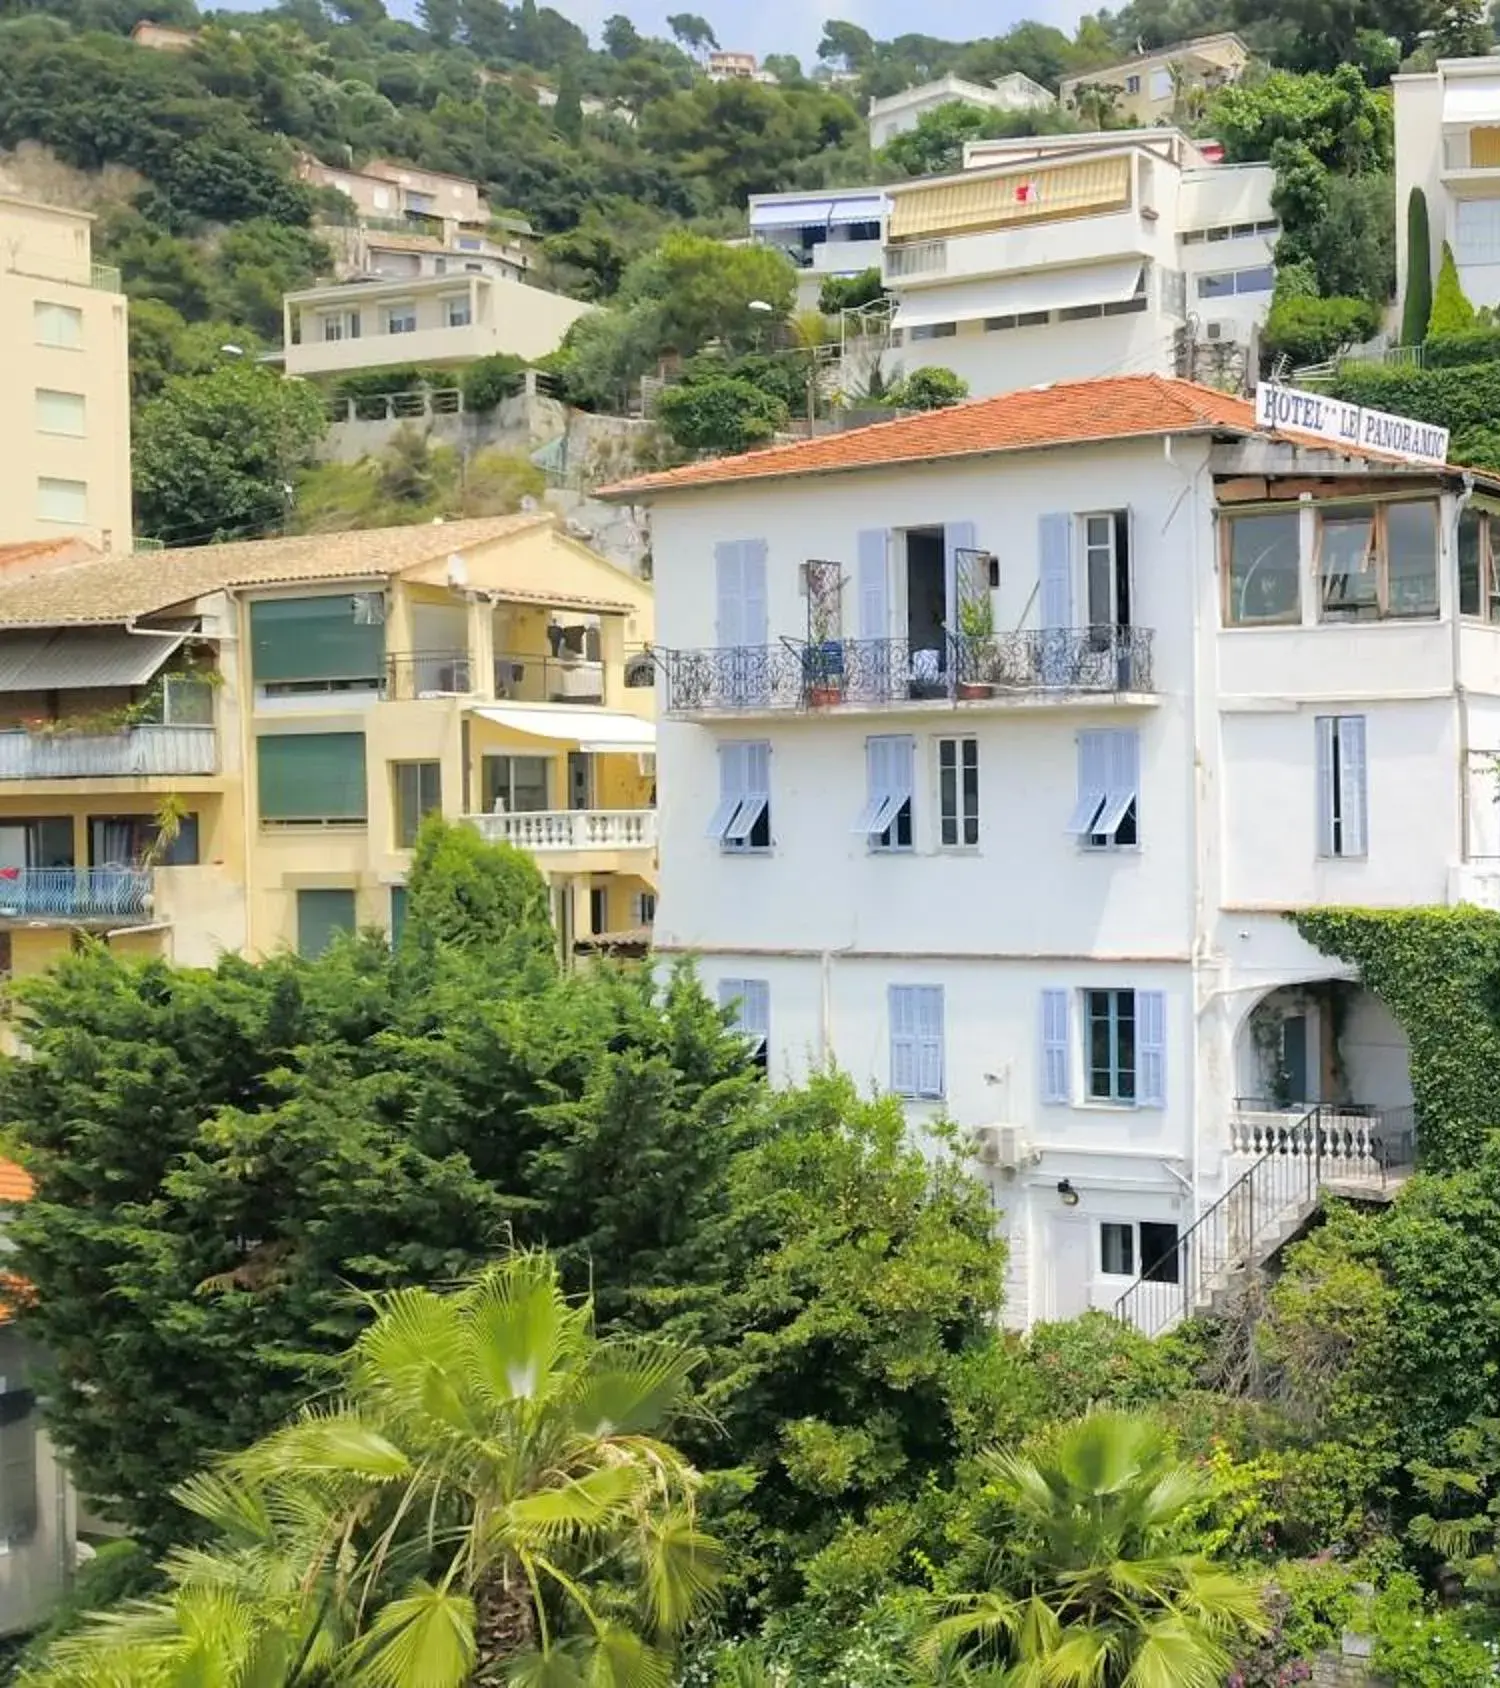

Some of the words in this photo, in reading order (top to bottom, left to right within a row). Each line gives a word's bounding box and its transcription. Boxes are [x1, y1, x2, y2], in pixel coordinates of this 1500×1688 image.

[1263, 389, 1322, 431] HOTEL
[1339, 408, 1357, 438] LE
[1364, 414, 1445, 458] PANORAMIC
